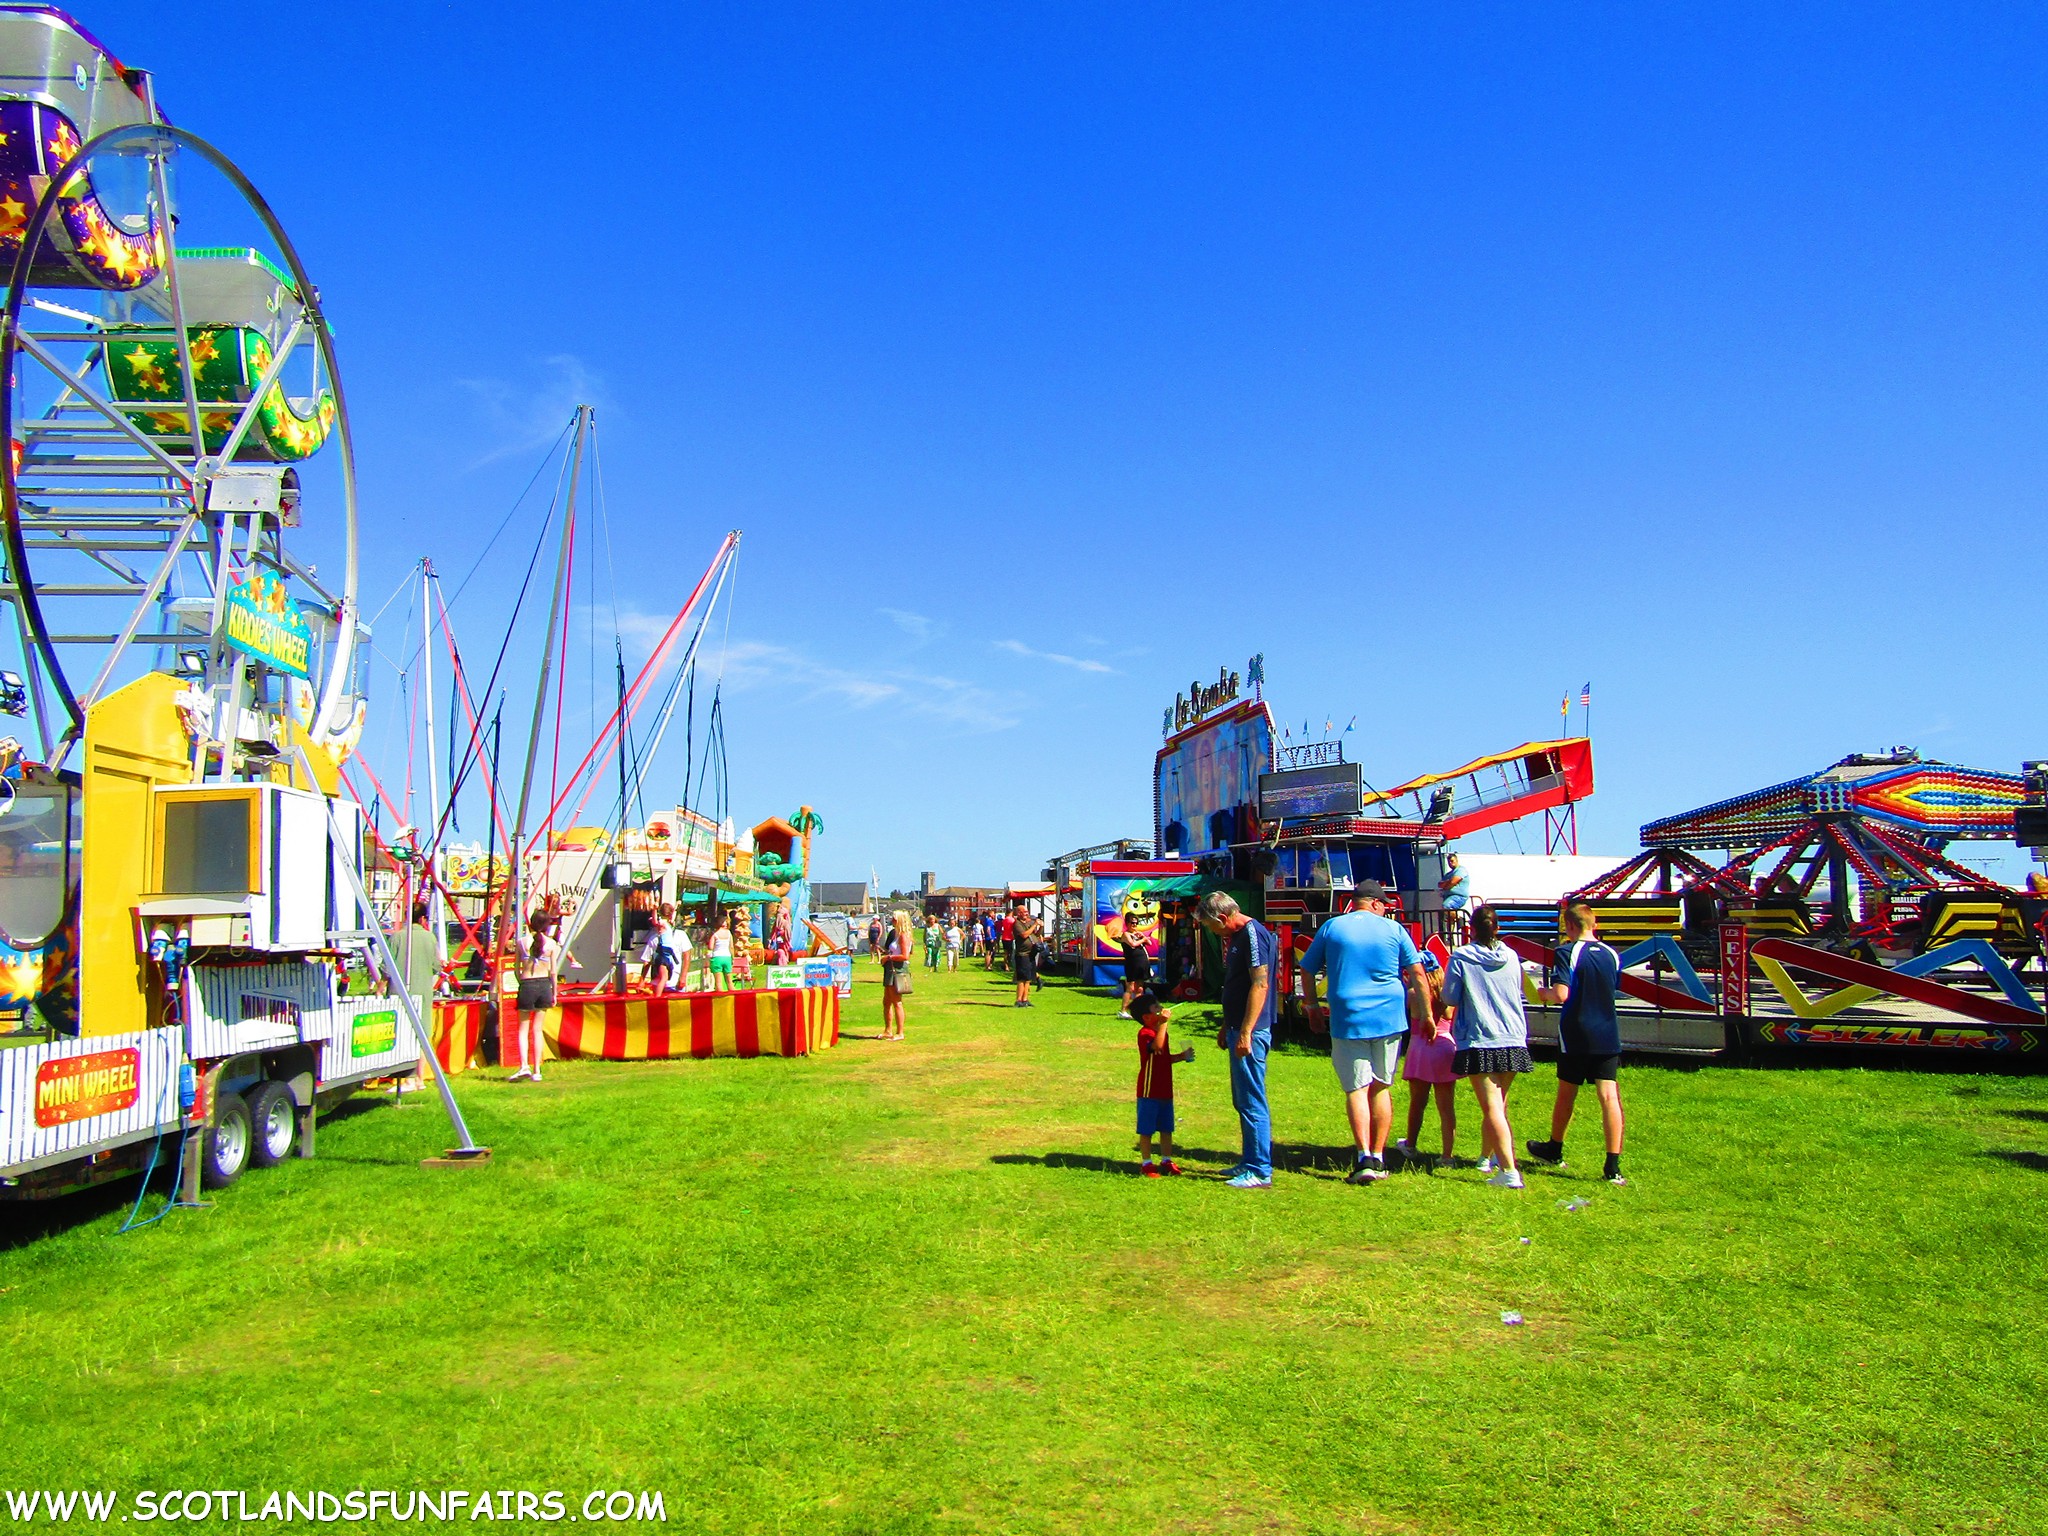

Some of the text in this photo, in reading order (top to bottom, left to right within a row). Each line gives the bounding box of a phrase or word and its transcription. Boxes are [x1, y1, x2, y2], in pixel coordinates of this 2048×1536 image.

[228, 602, 308, 673] KIDDIES WHEEL
[1276, 741, 1340, 769] EVANS
[1890, 896, 1921, 904] SMALLEST
[1725, 941, 1741, 1009] EVANS
[1807, 1024, 1987, 1049] SIZZLER
[39, 1064, 136, 1109] MINI WHEEL
